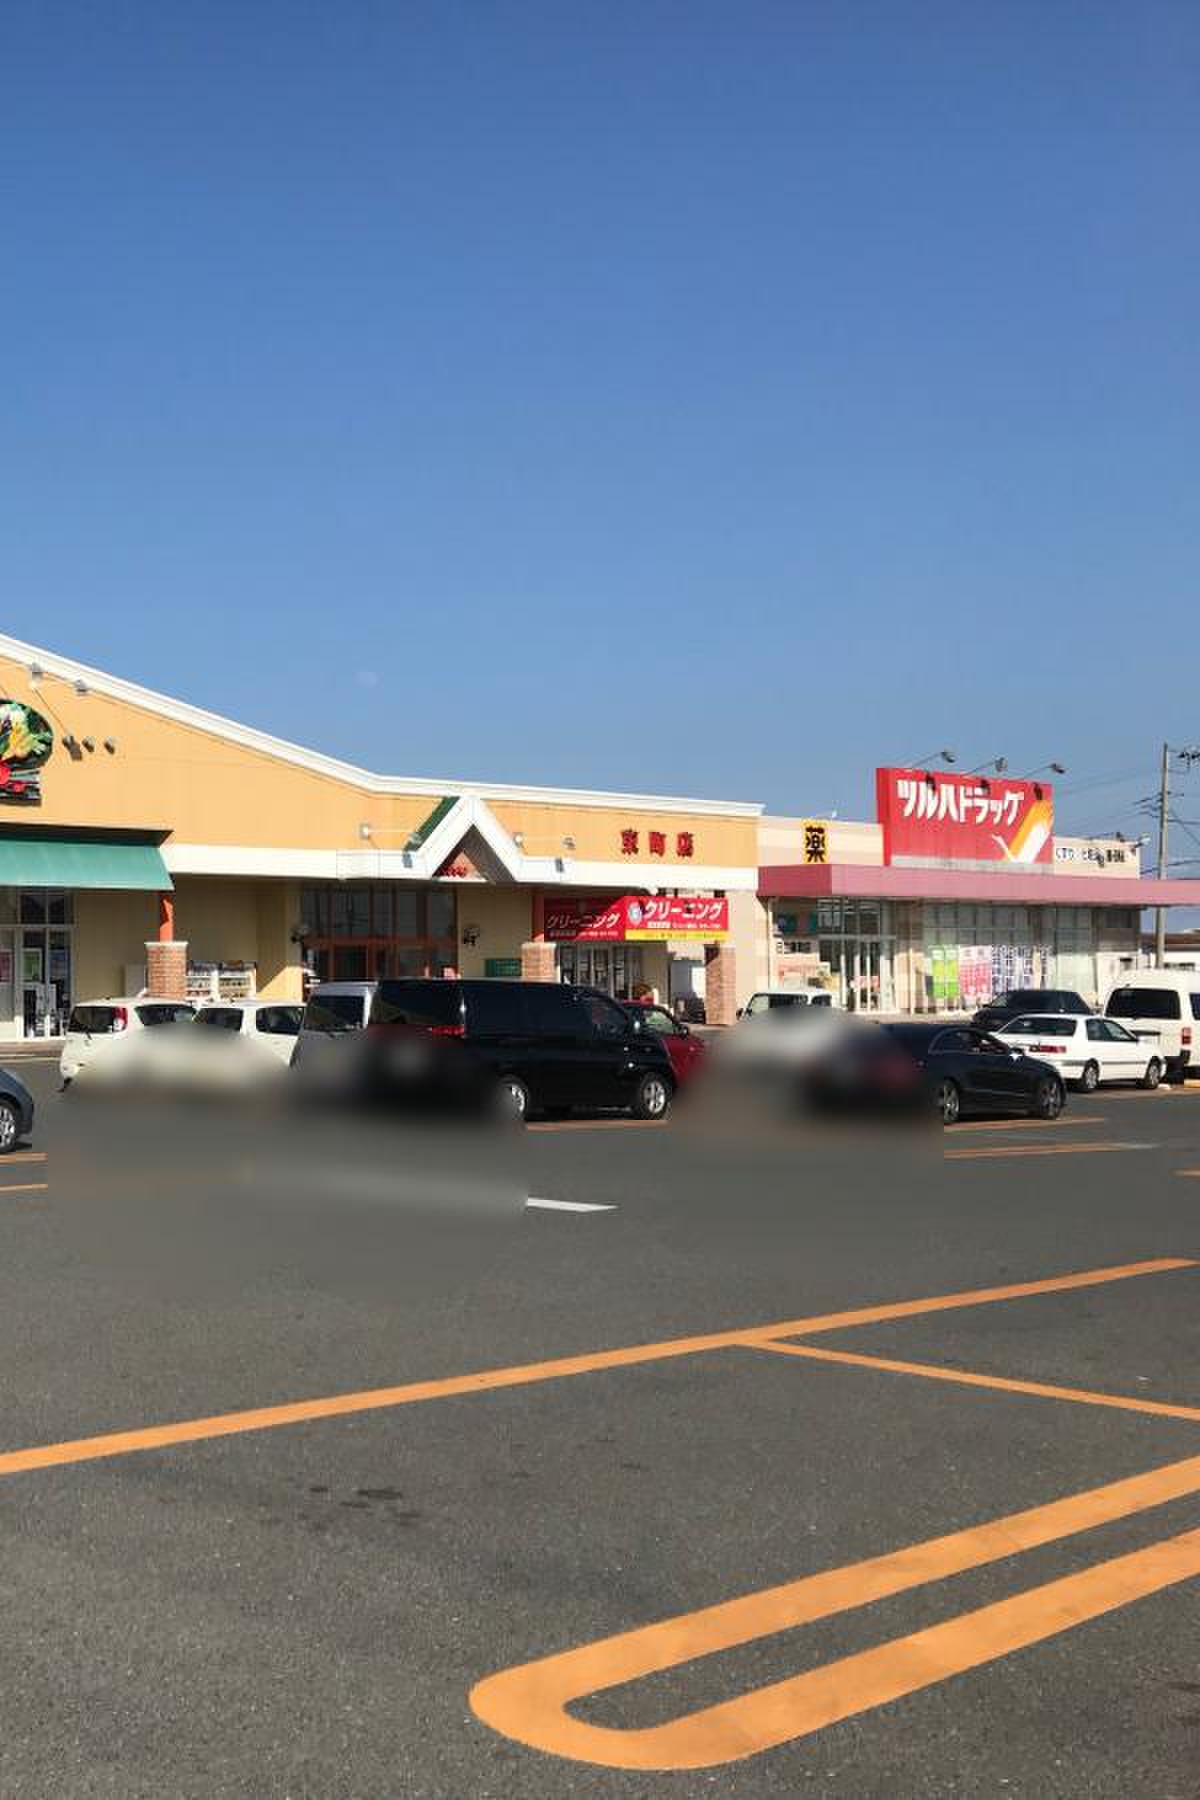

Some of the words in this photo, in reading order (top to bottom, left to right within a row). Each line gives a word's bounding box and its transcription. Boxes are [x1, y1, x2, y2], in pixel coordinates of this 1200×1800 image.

[897, 779, 1024, 826] ツルハドラッグ
[805, 826, 825, 863] 薬
[547, 912, 620, 929] クリーニング
[643, 901, 723, 921] クリーニング
